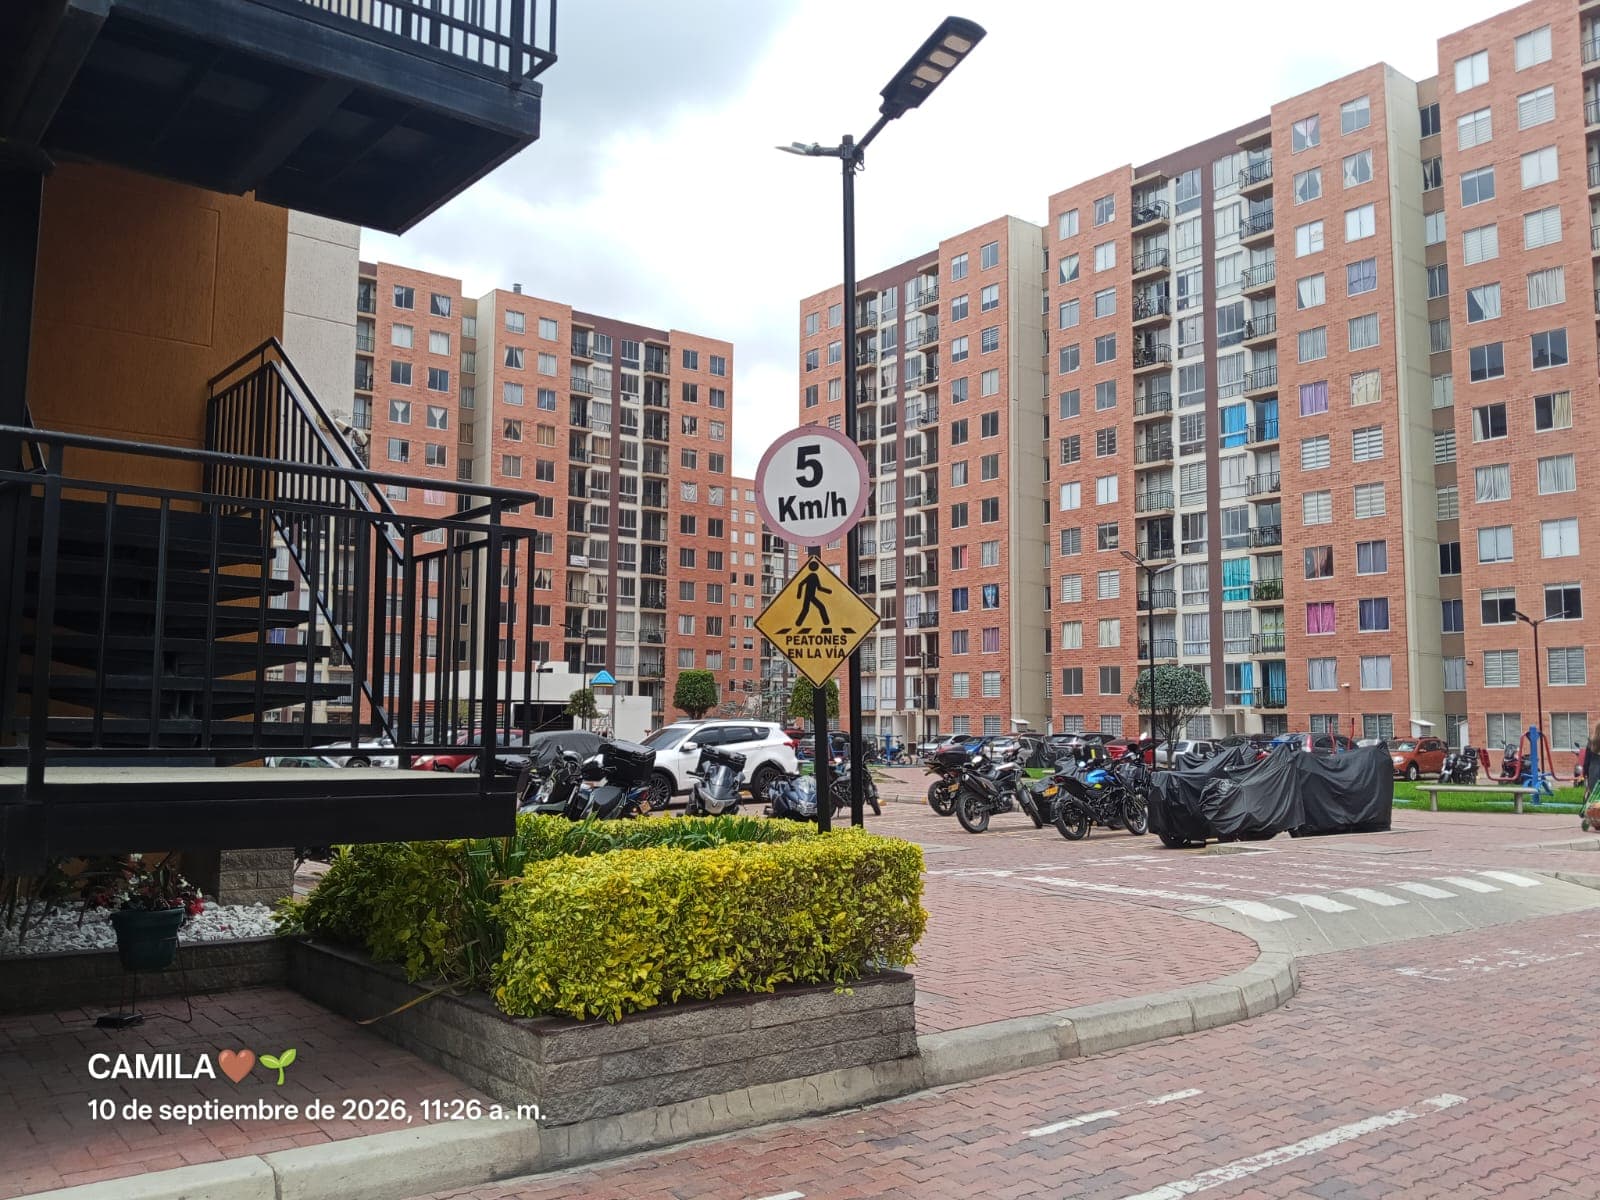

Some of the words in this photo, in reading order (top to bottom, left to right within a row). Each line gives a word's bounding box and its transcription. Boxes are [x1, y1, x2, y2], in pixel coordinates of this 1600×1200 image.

[796, 444, 823, 488] 5
[778, 491, 847, 522] Km/h
[786, 635, 847, 645] PEATONES
[788, 648, 803, 659] EN
[807, 648, 822, 659] LA
[826, 646, 846, 659] VÍA
